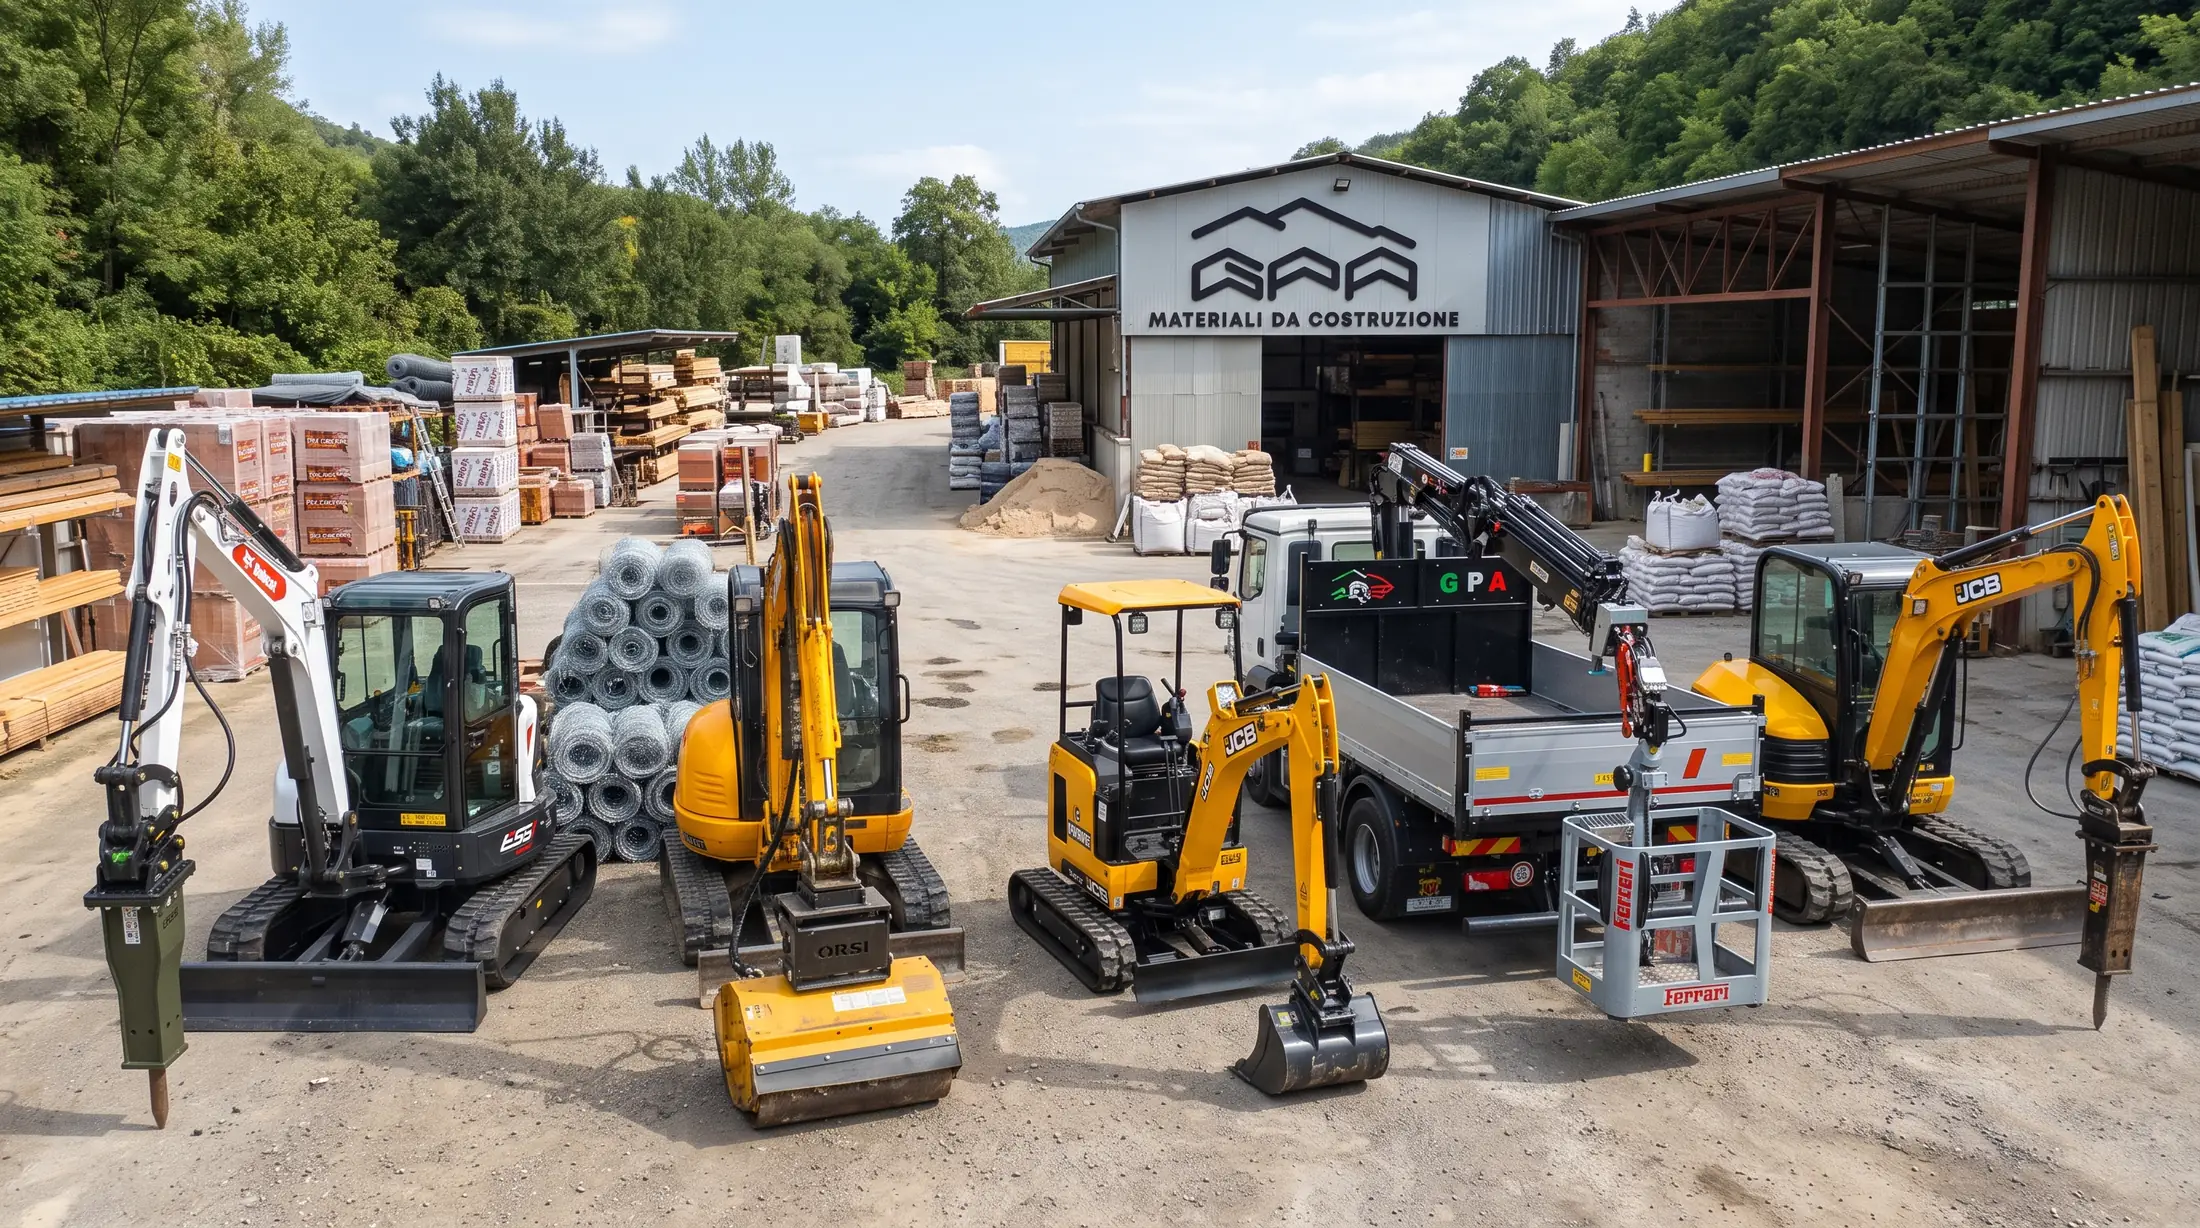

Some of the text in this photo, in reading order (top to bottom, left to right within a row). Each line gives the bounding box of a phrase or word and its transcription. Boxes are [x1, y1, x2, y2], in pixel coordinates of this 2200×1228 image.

[1148, 311, 1460, 328] MATERIALI DA COSTRUZIONE
[1956, 573, 2002, 605] JCB
[1224, 722, 1257, 756] JCB
[1086, 876, 1109, 904] JCB
[818, 941, 869, 958] ORSI
[1663, 983, 1729, 1006] Ferrari
